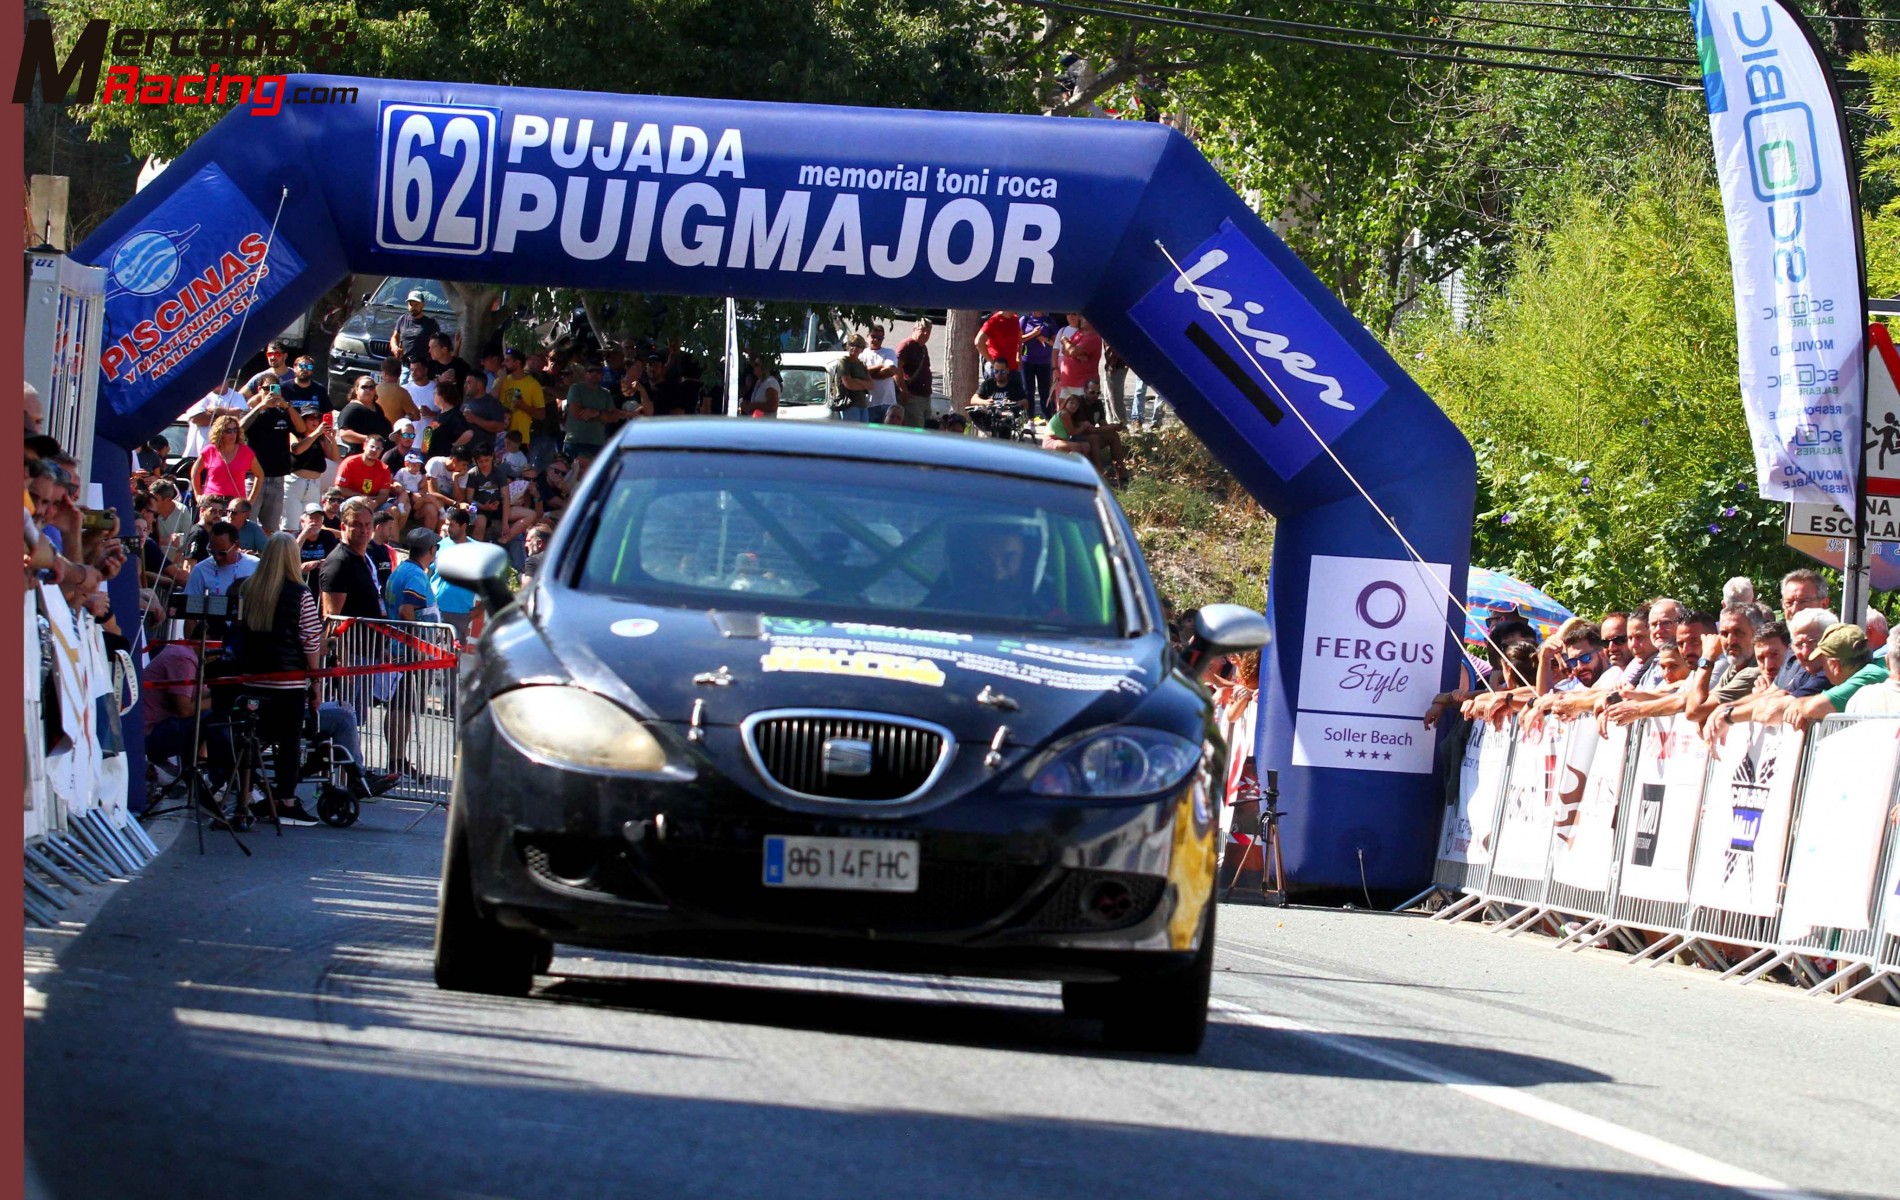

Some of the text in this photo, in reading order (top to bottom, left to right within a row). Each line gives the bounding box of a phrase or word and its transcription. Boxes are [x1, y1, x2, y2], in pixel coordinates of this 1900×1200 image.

[507, 114, 745, 179] PUJADA
[392, 114, 481, 245] 62
[799, 164, 1058, 199] memorial toni roca
[493, 171, 1062, 285] PUIGMAJOR
[100, 233, 268, 382] PISCINAS
[123, 265, 269, 384] Y MANTENIMIENTOS
[151, 313, 232, 381] MALLORCA
[1315, 636, 1434, 664] FERGUS
[1339, 663, 1409, 704] Style
[1324, 727, 1412, 746] Soller Beach
[788, 848, 910, 879] 8614FHC
